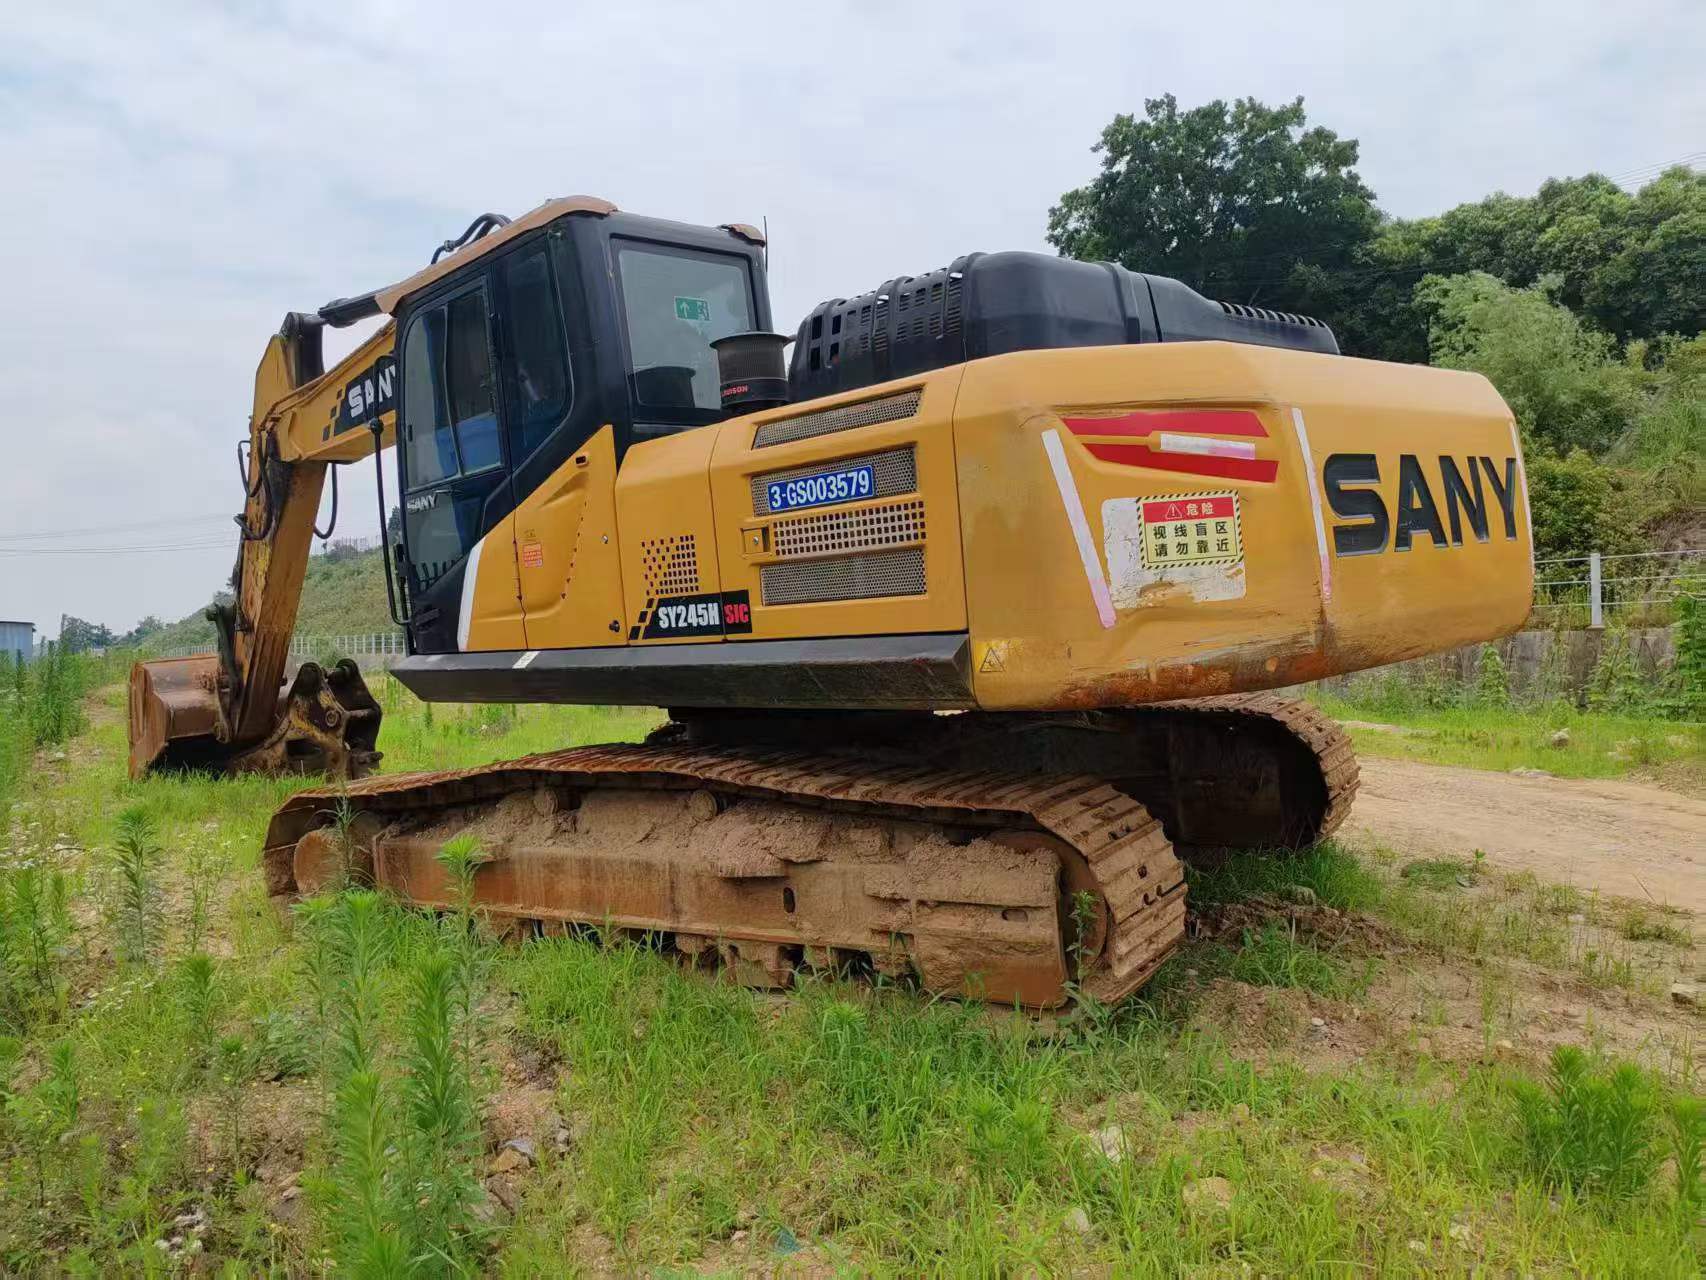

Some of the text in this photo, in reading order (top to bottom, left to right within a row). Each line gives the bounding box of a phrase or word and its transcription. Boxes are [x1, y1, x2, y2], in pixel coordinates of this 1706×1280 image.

[770, 469, 870, 507] 3-GS003579
[1186, 502, 1215, 516] 危险
[1323, 453, 1518, 557] SANY
[1153, 521, 1228, 540] 视线盲区
[1154, 538, 1230, 558] 请勿靠近
[658, 602, 720, 629] SY245H
